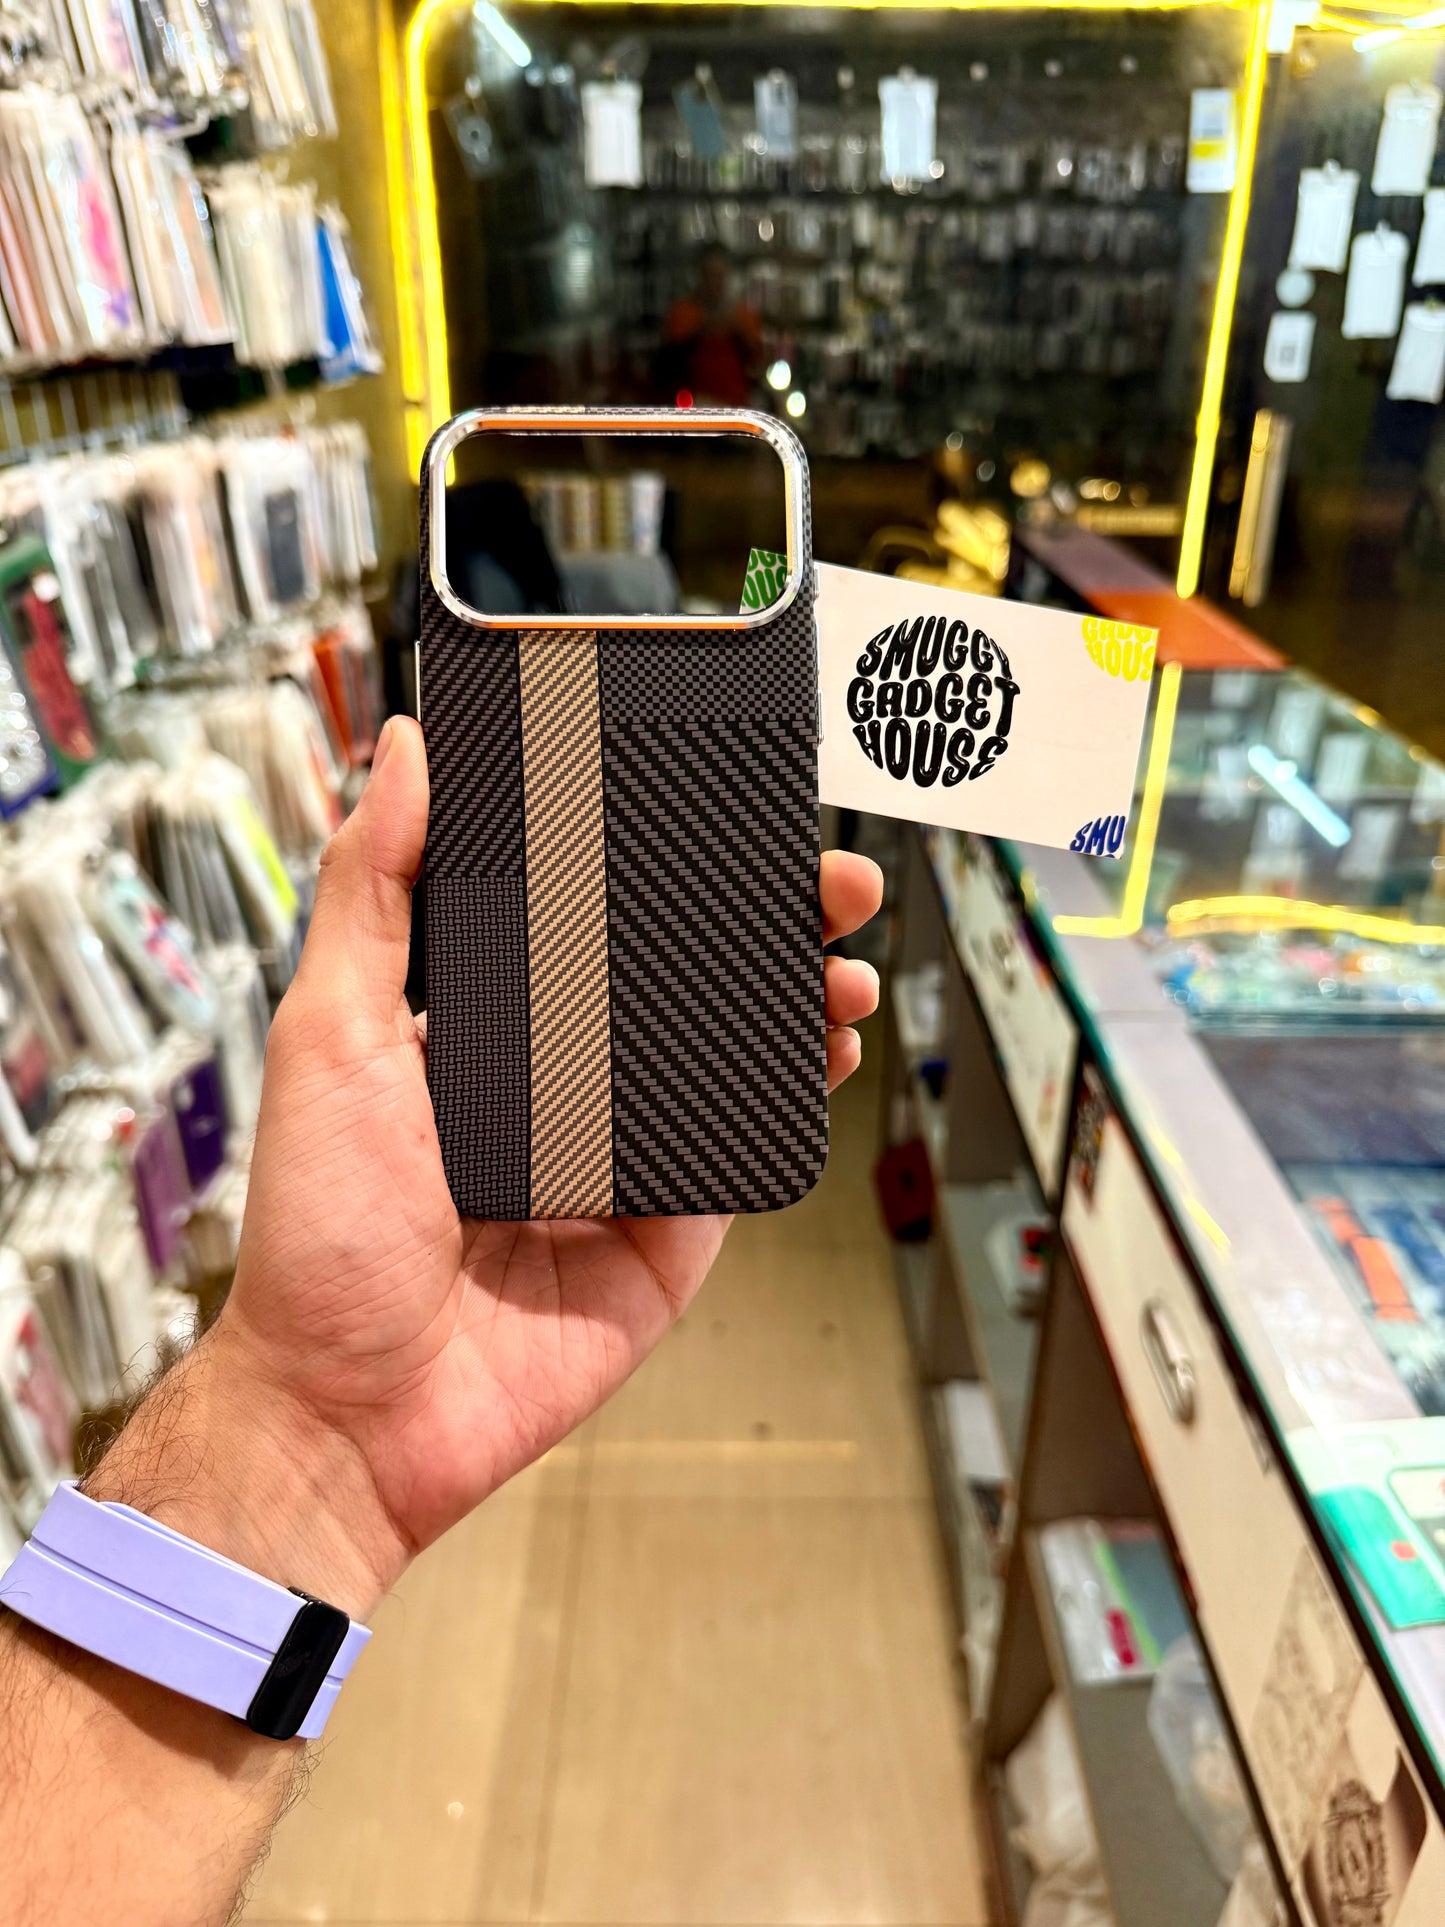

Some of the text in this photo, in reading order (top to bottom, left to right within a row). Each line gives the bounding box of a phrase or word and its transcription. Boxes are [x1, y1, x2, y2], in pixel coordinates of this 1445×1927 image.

[856, 615, 1013, 682] SMUGGY
[847, 672, 1021, 738] GADGET
[852, 717, 1009, 788] HOUSE
[1069, 815, 1126, 856] SMU
